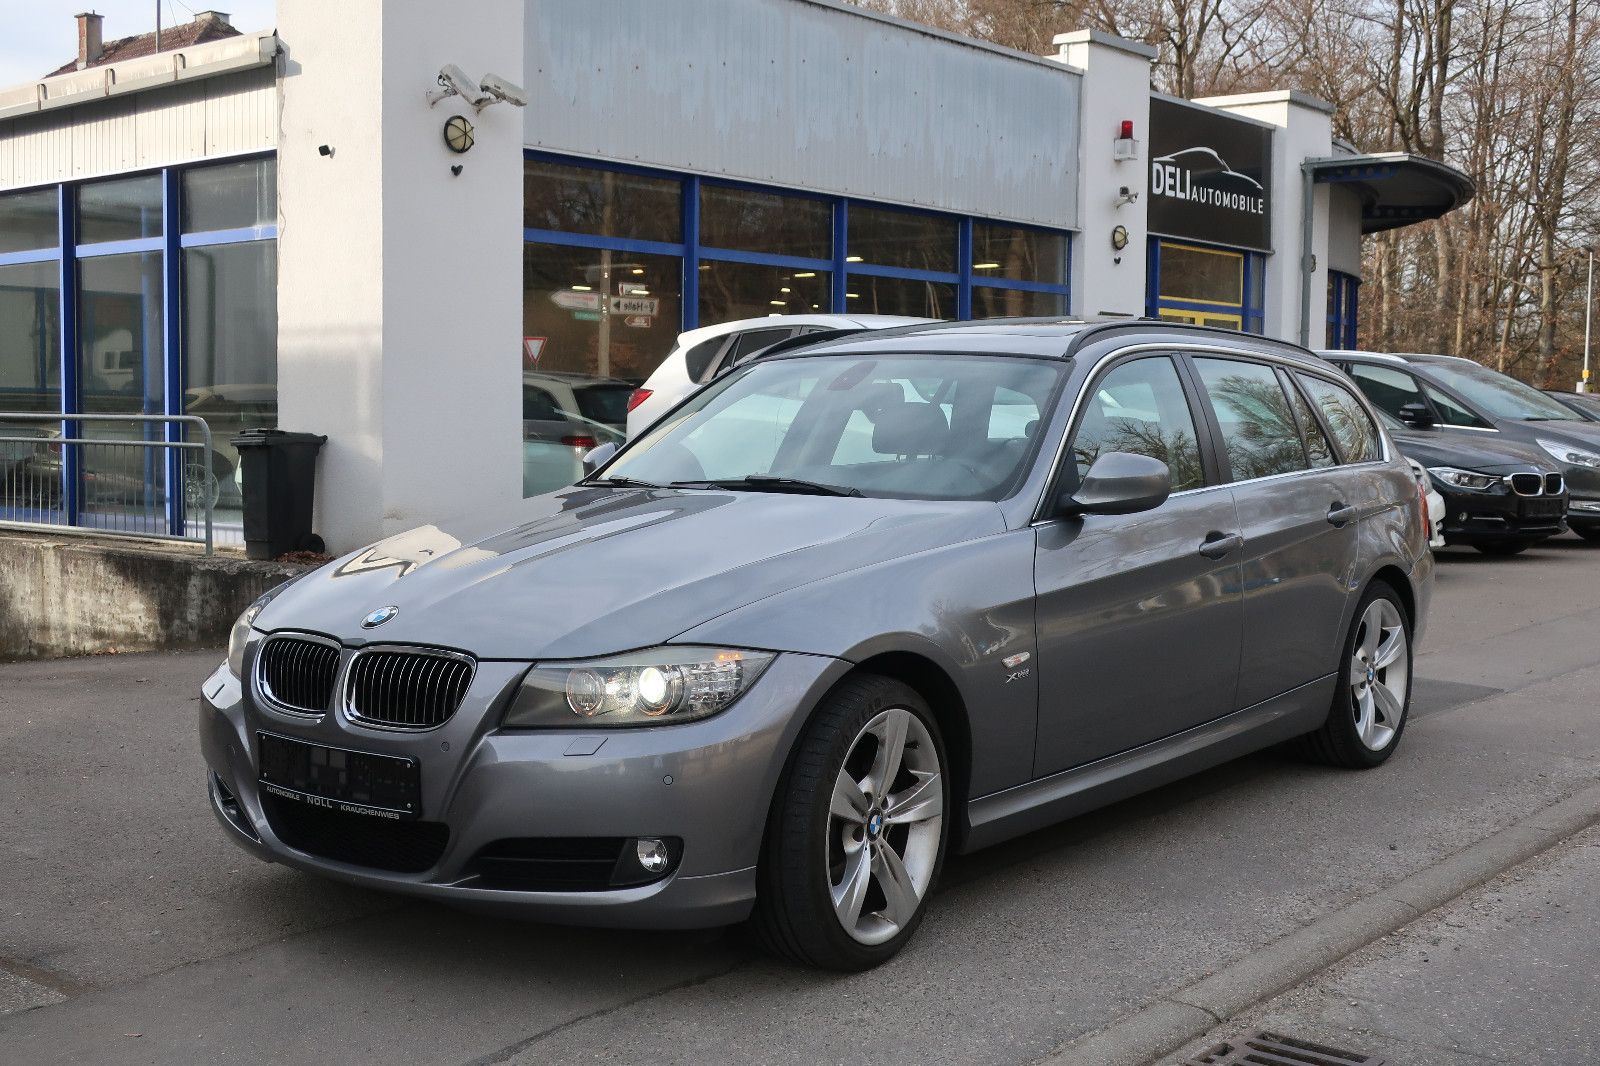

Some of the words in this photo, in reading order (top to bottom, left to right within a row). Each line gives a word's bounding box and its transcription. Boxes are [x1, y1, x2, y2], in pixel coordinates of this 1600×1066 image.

[1152, 162, 1191, 201] DELI
[1191, 185, 1264, 215] AUTOMOBILE
[306, 795, 333, 809] NOLL
[340, 804, 400, 820] KRAUCHENWIES
